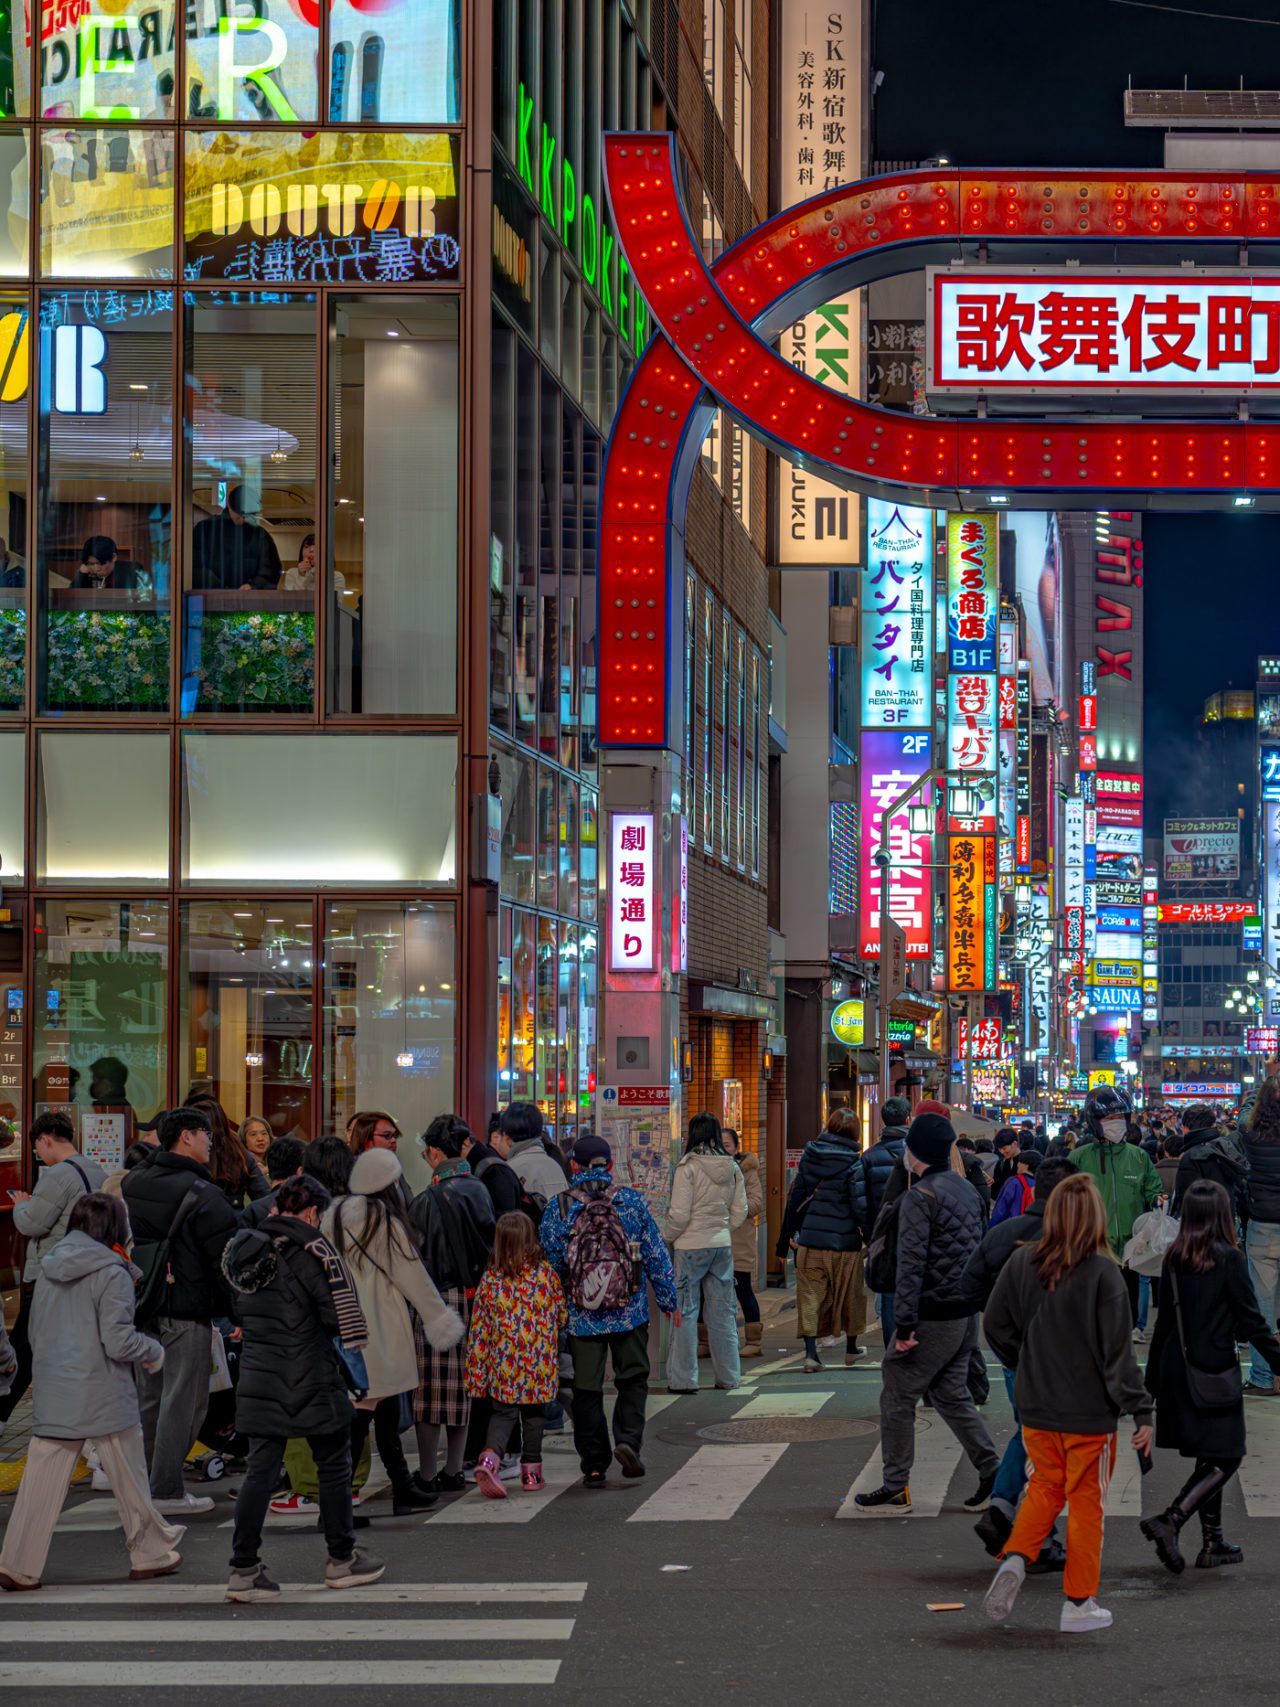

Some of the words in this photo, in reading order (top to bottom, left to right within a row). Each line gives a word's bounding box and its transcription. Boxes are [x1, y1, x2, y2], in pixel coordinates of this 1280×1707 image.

[211, 179, 436, 238] DOUTOR
[957, 521, 988, 641] まぐろ商店
[870, 558, 905, 682] バンタイ
[910, 561, 926, 674] タイ国料理専門店
[952, 649, 992, 667] B1F
[868, 698, 924, 706] RESTAURANT
[882, 709, 909, 724] 3F
[902, 735, 928, 754] 2F
[959, 817, 985, 832] 4F
[620, 825, 646, 958] 劇場通り
[1172, 904, 1255, 914] ゴールドラッシュ
[1092, 987, 1142, 1005] SAUNA
[888, 1020, 914, 1031] ttoria
[4, 1031, 16, 1041] 2F
[4, 1053, 16, 1062] 1F
[2, 1076, 17, 1085] B1F
